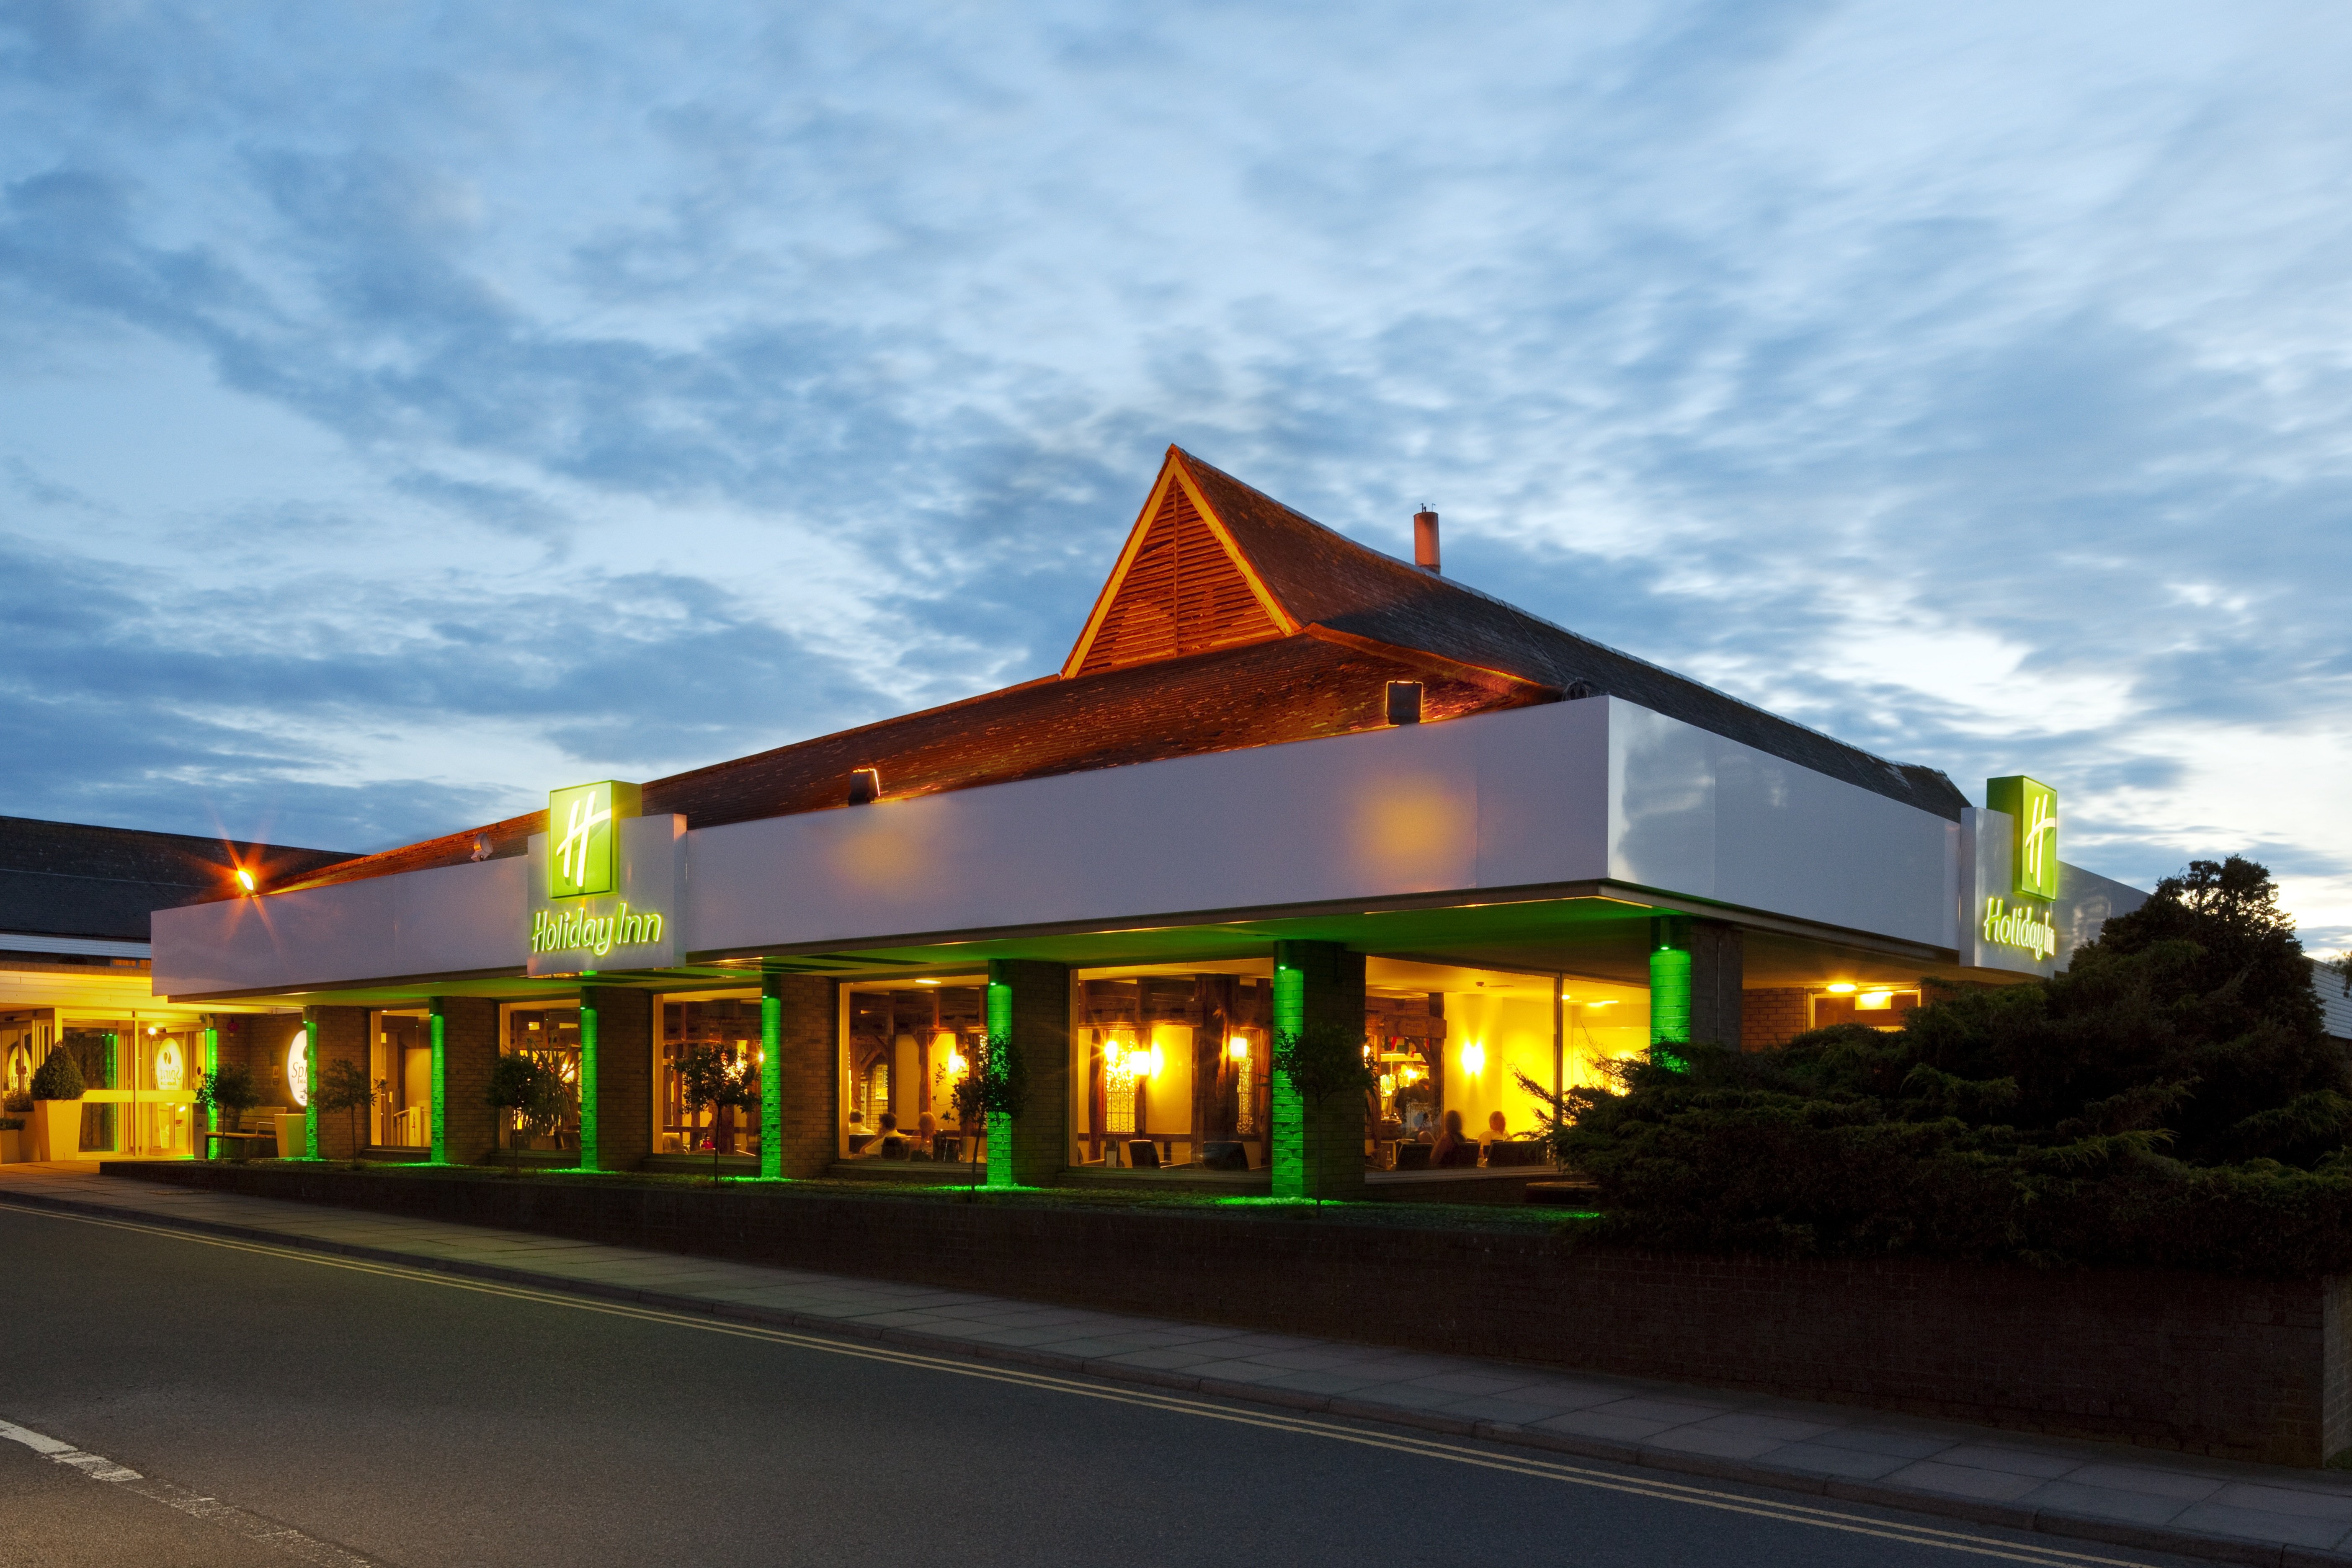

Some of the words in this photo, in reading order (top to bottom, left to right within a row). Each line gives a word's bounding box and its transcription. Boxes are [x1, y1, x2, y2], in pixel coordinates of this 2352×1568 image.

[532, 907, 614, 956] Holiday
[615, 903, 662, 944] Inn
[1984, 897, 2045, 961] Holiday
[2044, 911, 2055, 956] Inn
